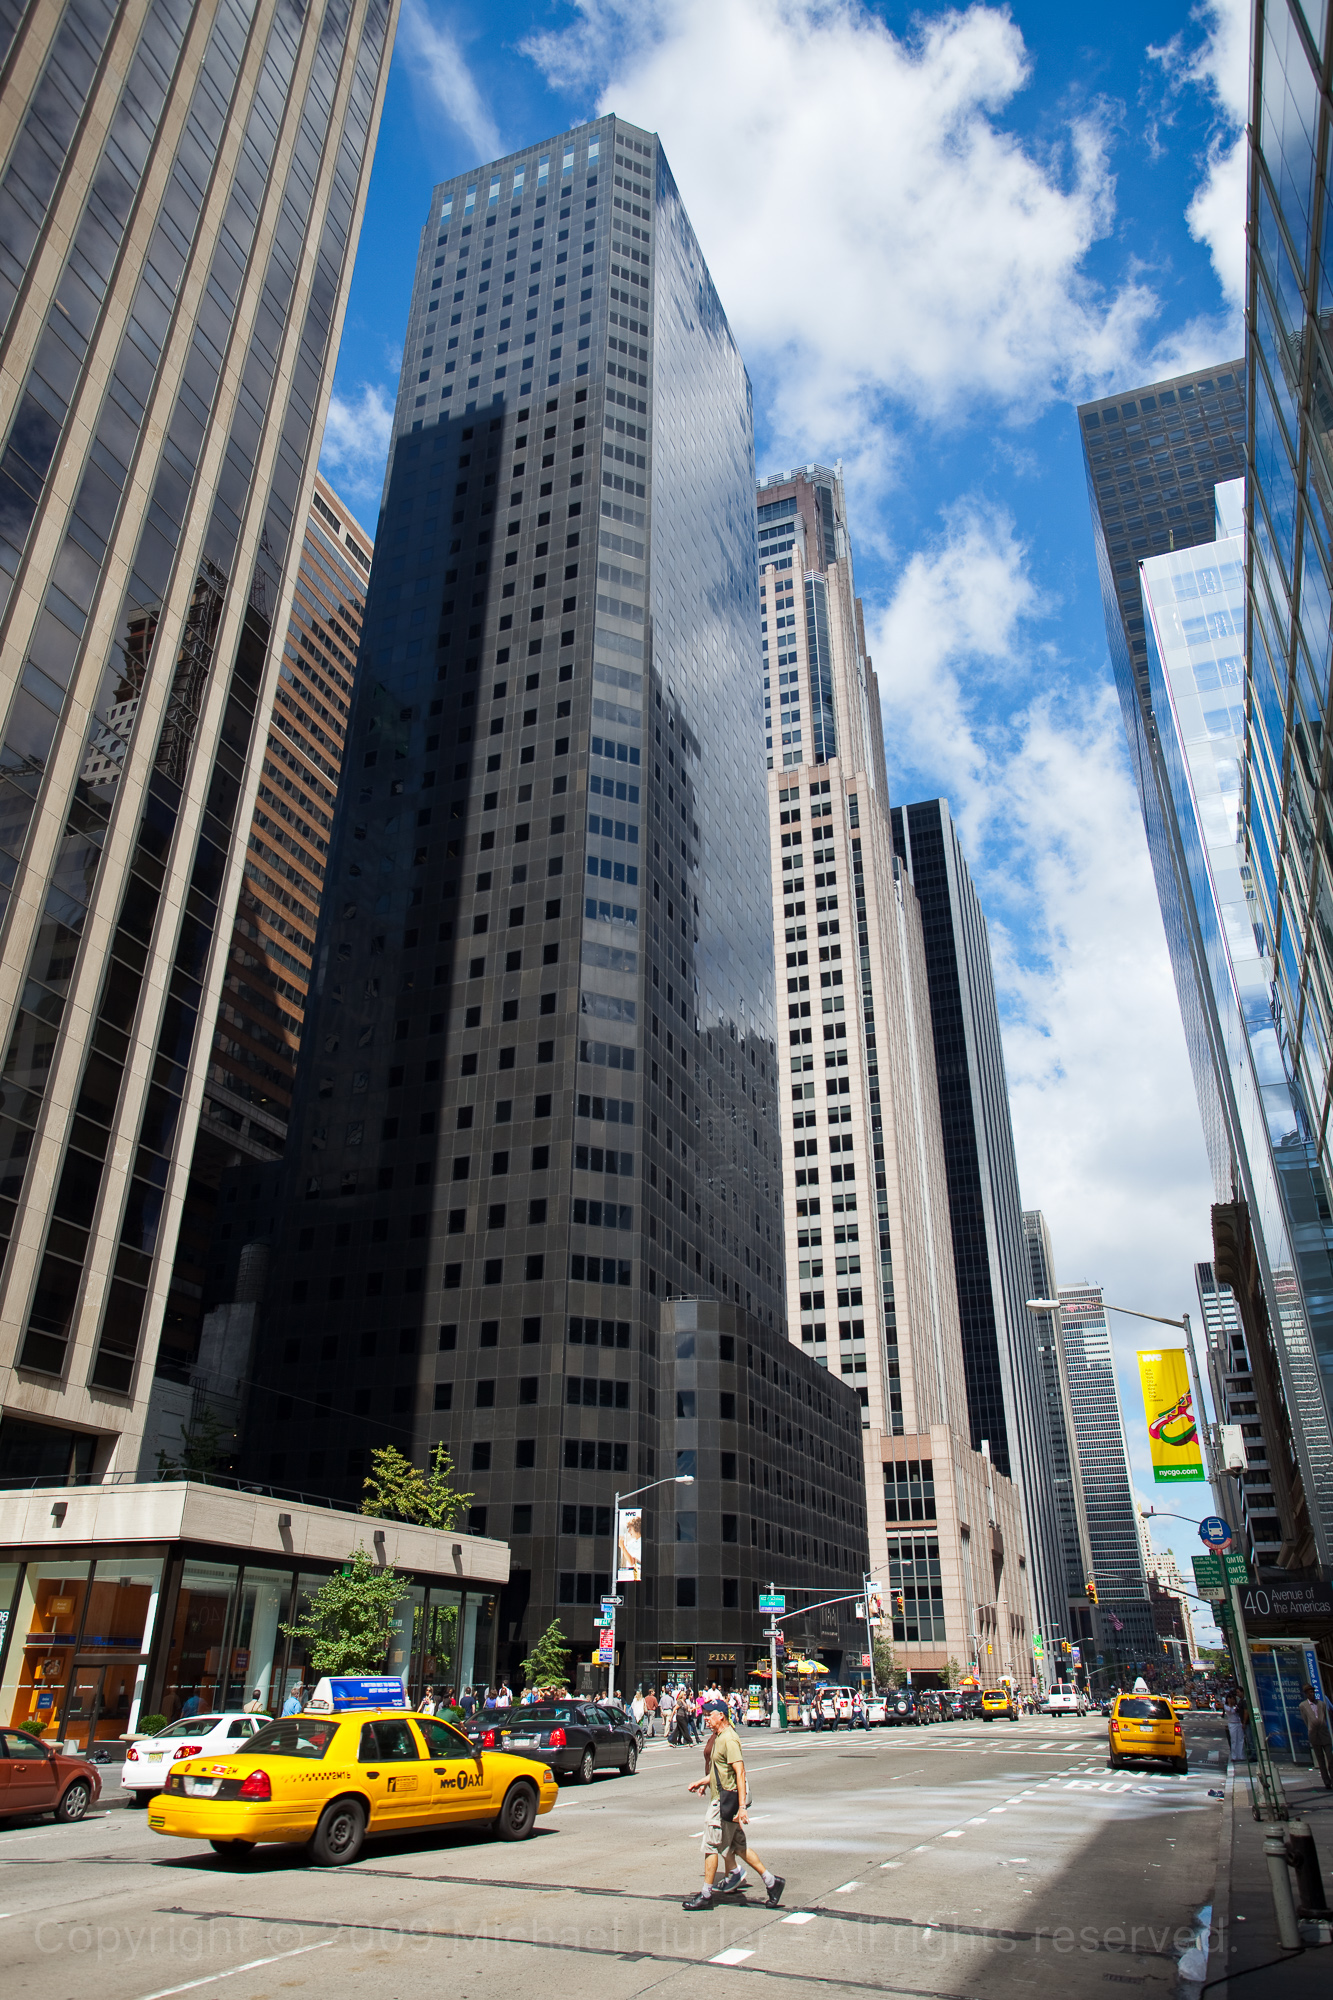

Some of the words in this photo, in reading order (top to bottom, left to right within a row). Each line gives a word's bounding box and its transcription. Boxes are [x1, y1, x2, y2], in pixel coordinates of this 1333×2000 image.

[1142, 1354, 1162, 1362] NYC
[1159, 1468, 1198, 1477] nycgo.com
[1226, 1555, 1244, 1564] QM10
[1228, 1566, 1246, 1574] QM12
[1230, 1576, 1249, 1584] QM22
[1244, 1590, 1270, 1615] 40
[1272, 1589, 1305, 1600] Avenue
[1306, 1587, 1315, 1599] of
[1273, 1603, 1288, 1614] the
[1289, 1601, 1331, 1613] Americas
[1083, 1766, 1200, 1781] ONLY
[440, 1778, 456, 1789] NYC
[457, 1770, 484, 1789] TAXI
[1062, 1779, 1164, 1795] BUS
